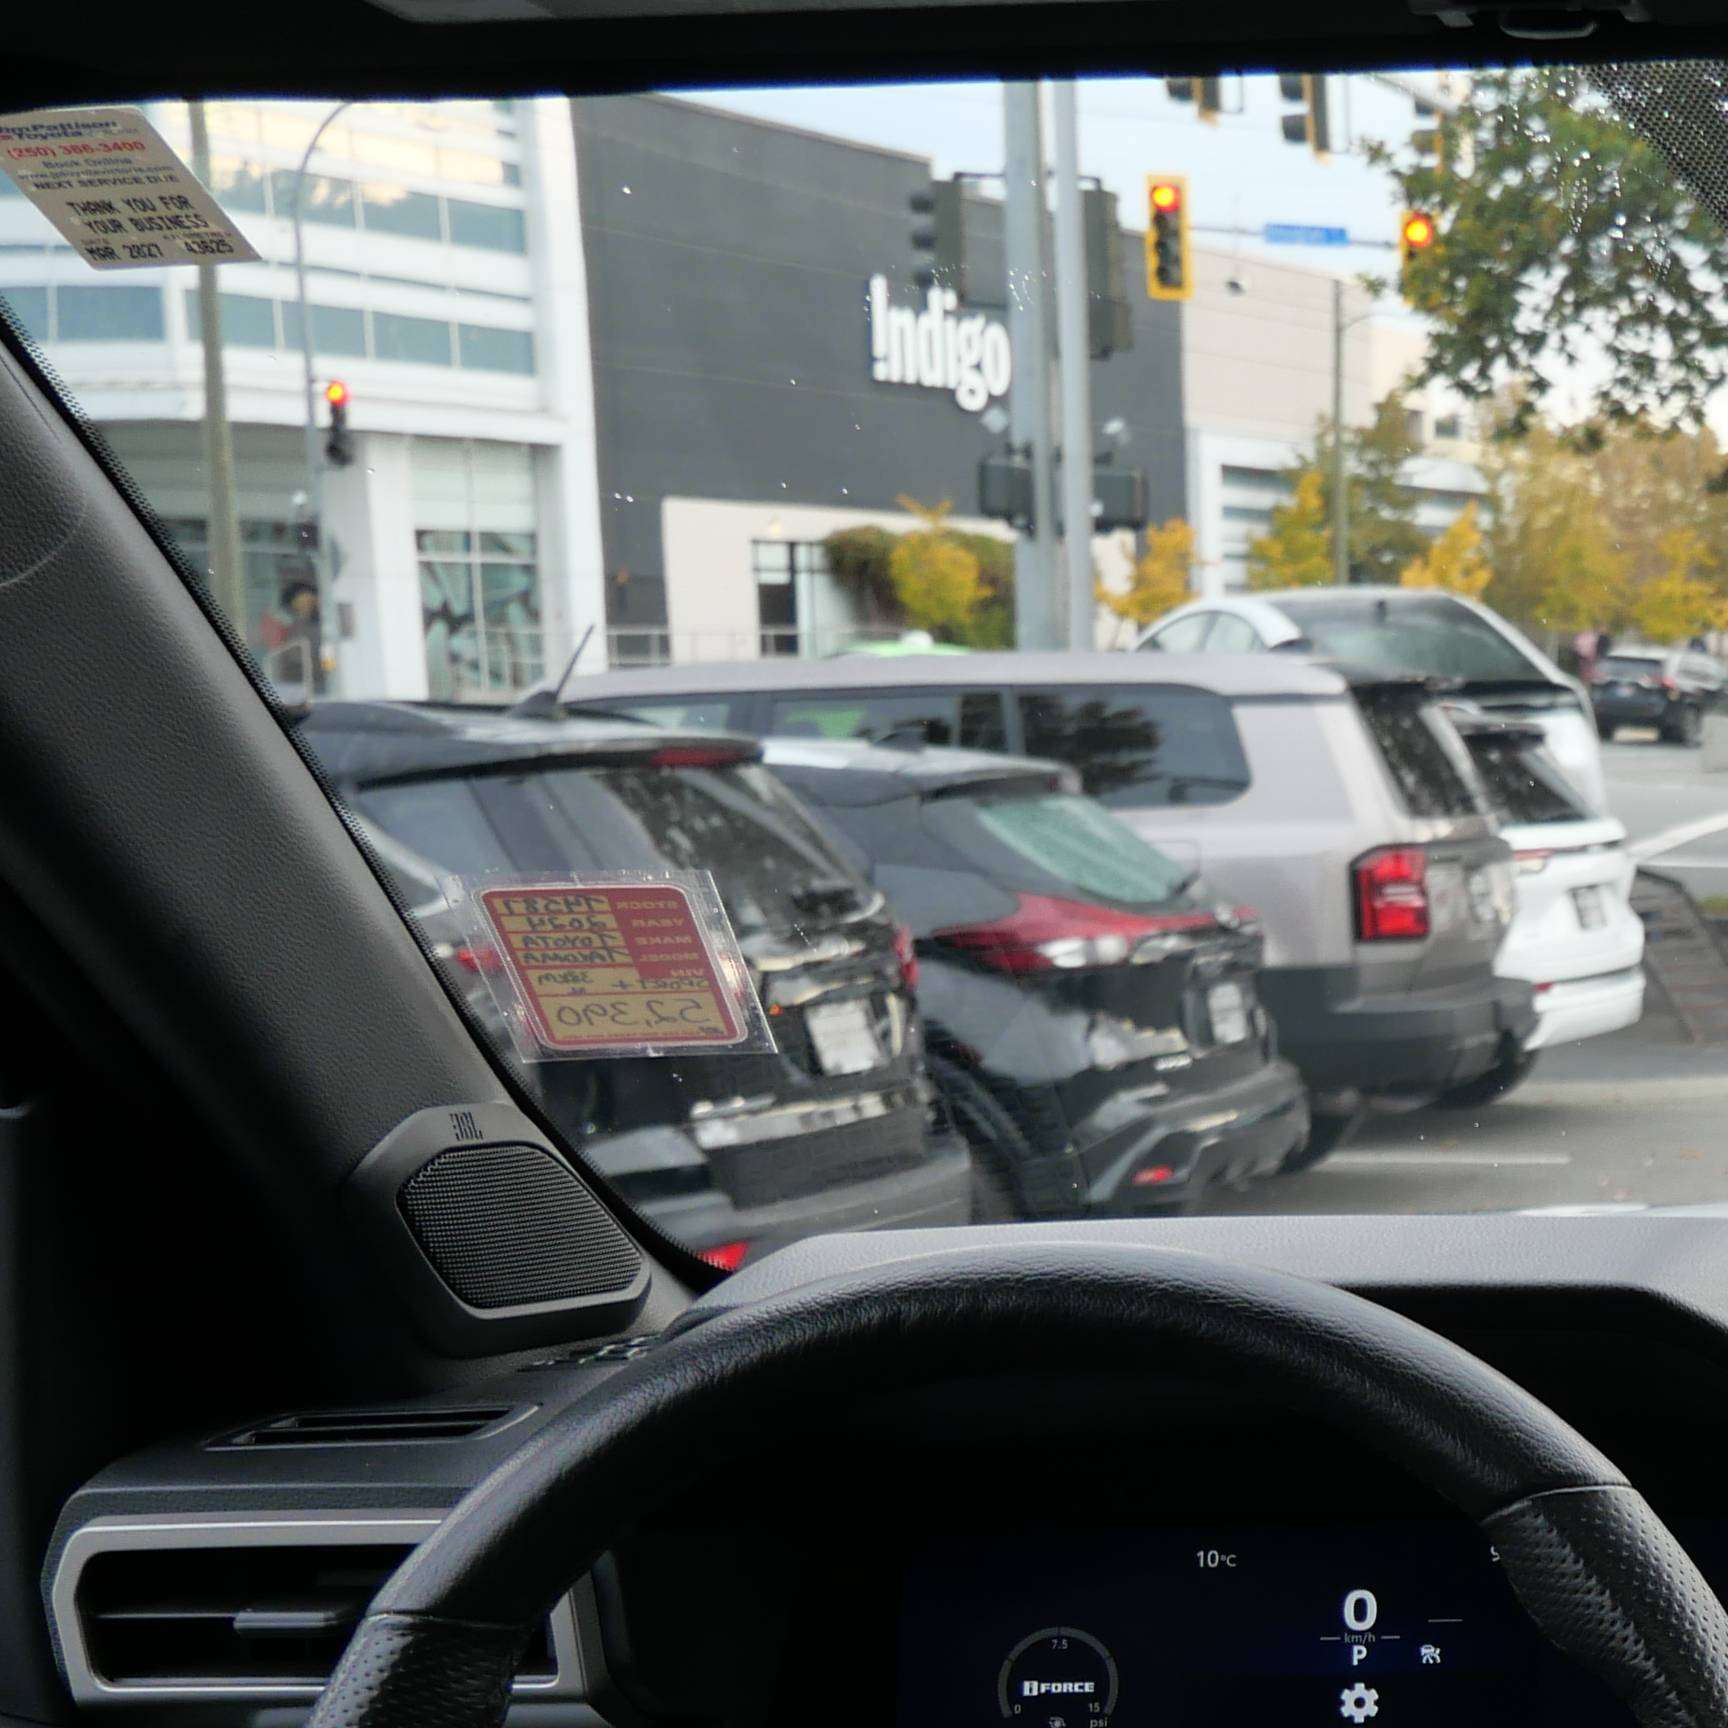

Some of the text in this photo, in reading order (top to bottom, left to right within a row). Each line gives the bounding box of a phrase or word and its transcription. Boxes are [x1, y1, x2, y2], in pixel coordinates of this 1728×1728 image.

[33, 174, 180, 190] NEXT SERVICE DUE
[66, 196, 195, 216] THANK YOU FOR
[82, 215, 210, 235] YOUR BUSINESS
[84, 247, 121, 261] MAR
[1343, 1589, 1378, 1631] 0
[1051, 1639, 1069, 1650] 7.5
[1344, 1632, 1376, 1644] km/h
[1352, 1645, 1367, 1666] P
[1088, 1702, 1101, 1714] 15
